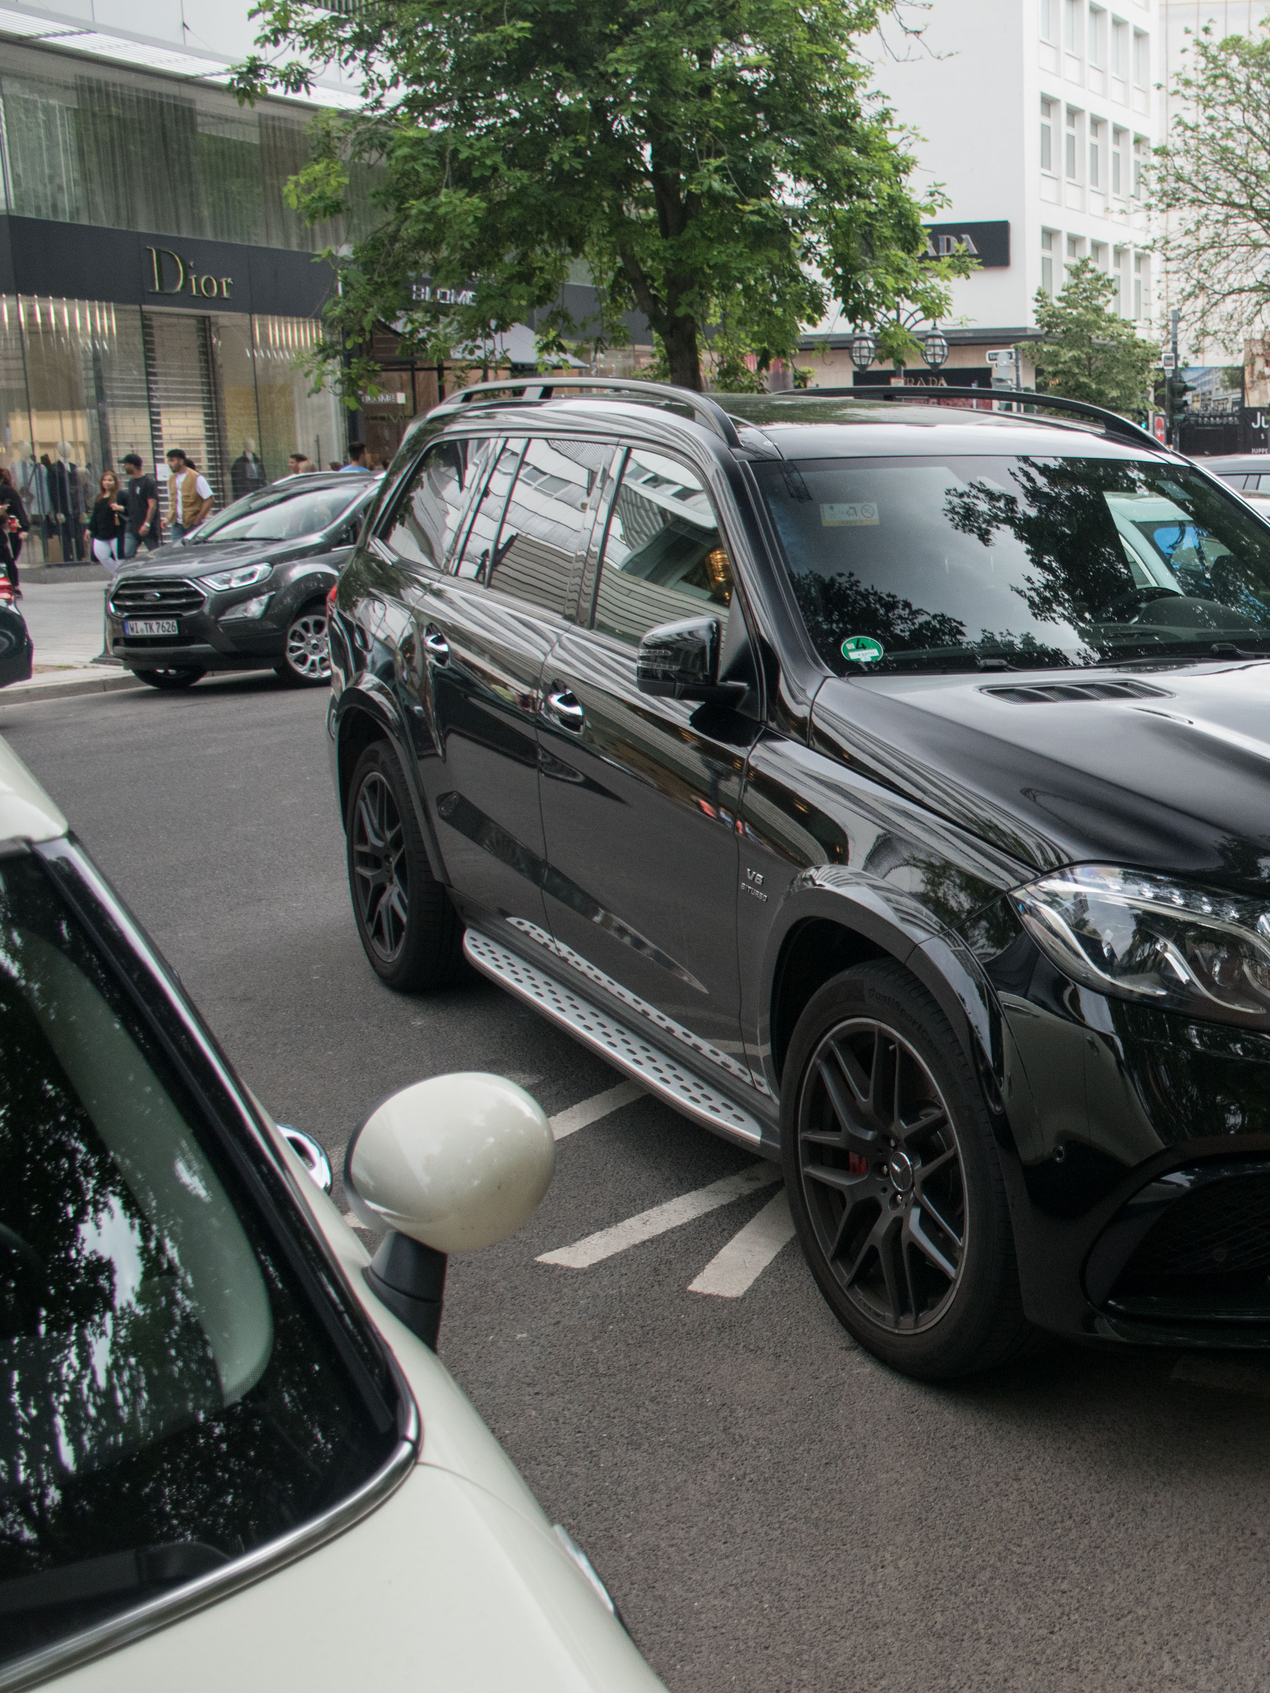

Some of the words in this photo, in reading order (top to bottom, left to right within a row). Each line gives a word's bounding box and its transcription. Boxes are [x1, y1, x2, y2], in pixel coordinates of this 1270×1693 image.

[146, 245, 234, 299] Dior
[855, 638, 867, 650] 4
[746, 868, 764, 885] V8
